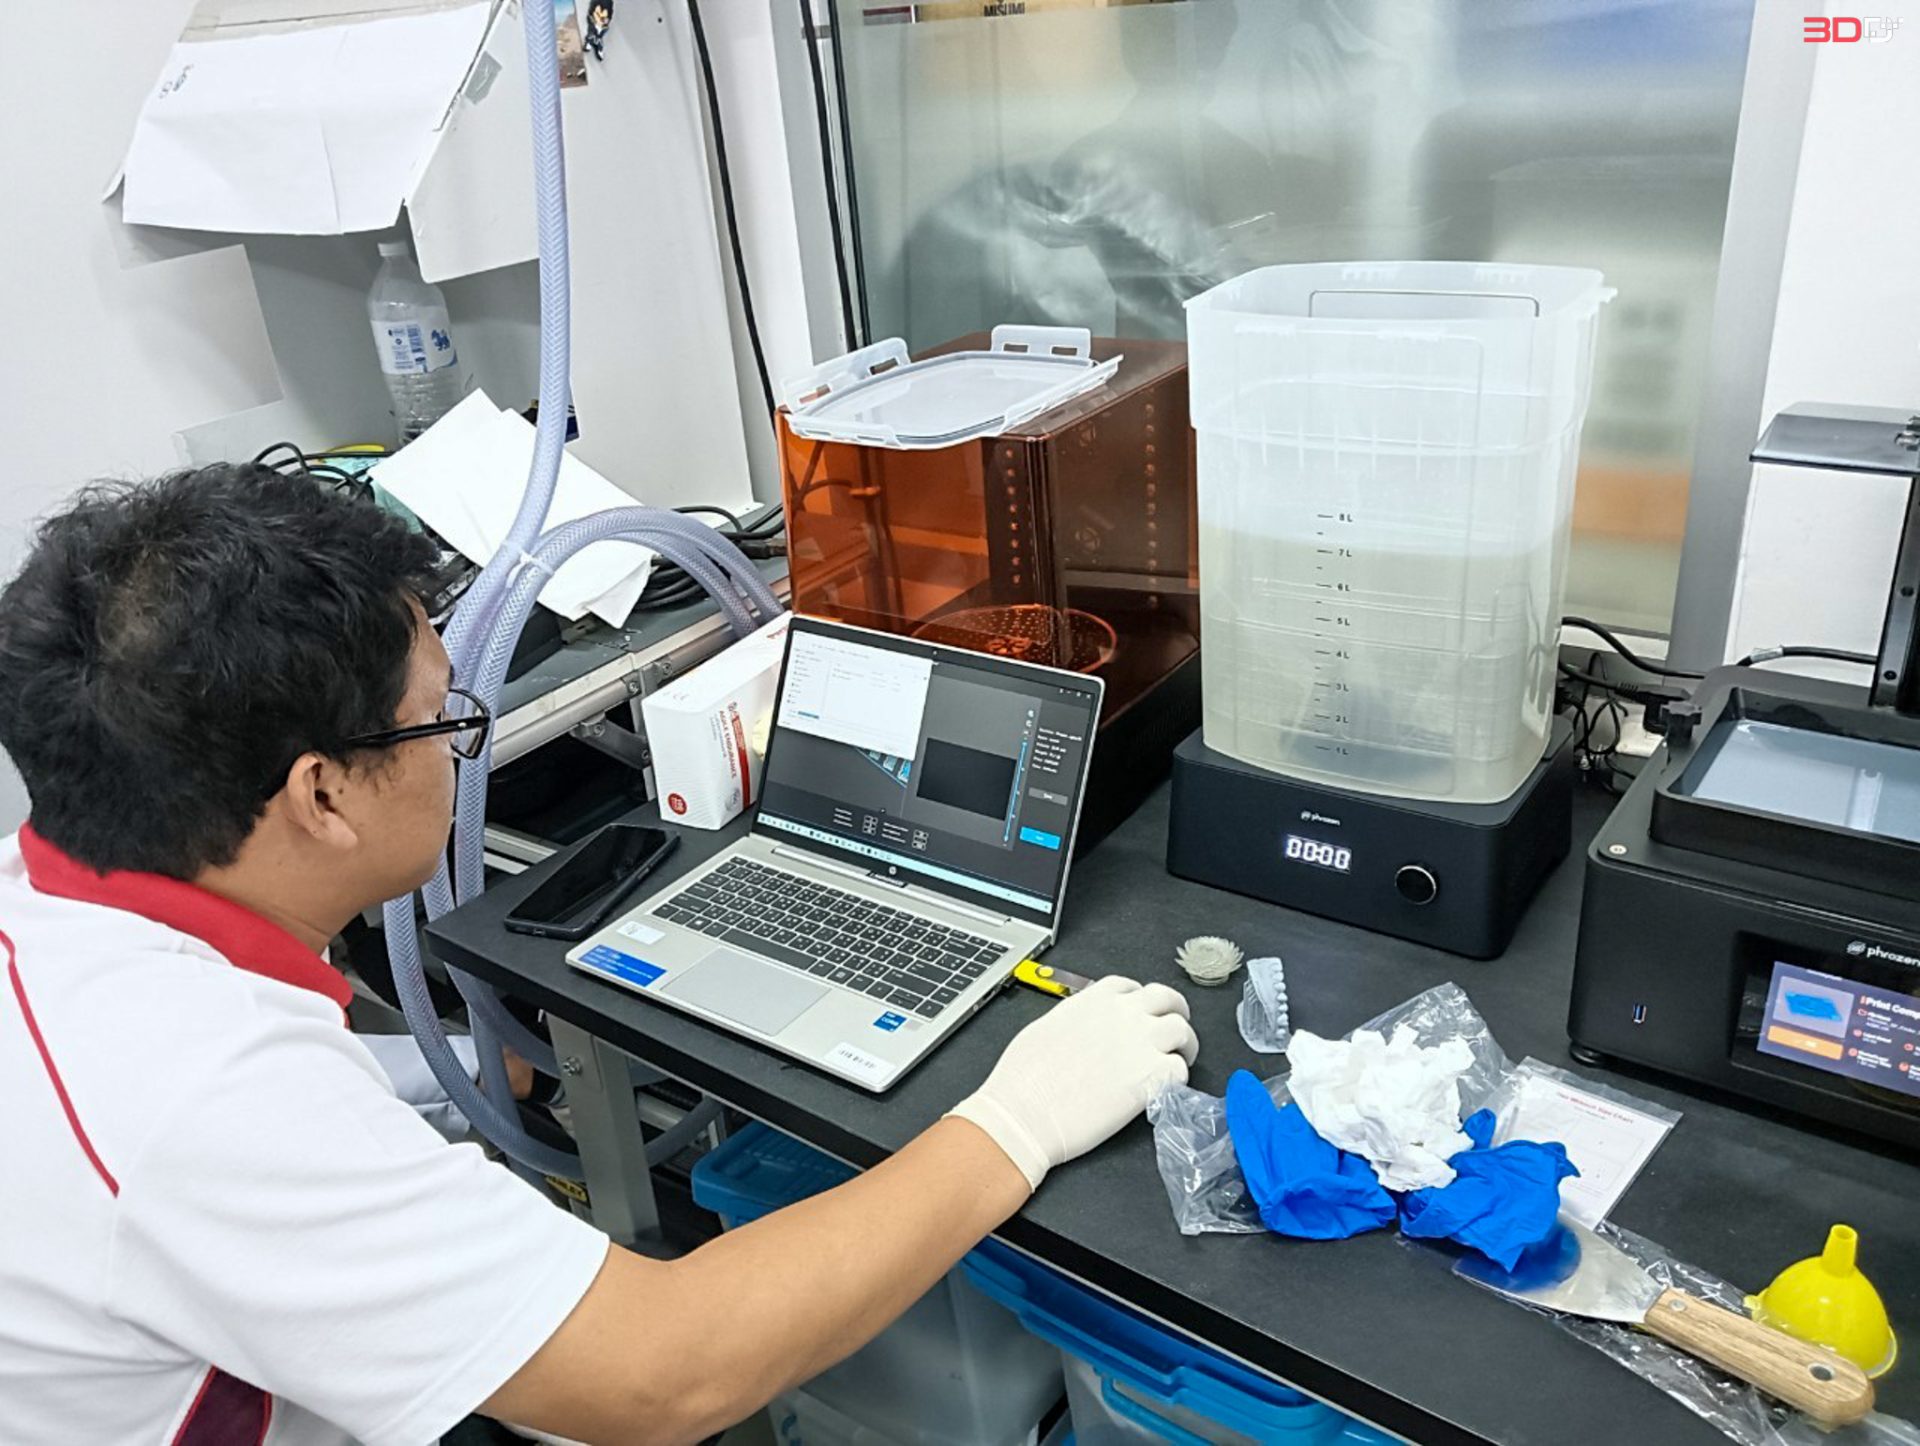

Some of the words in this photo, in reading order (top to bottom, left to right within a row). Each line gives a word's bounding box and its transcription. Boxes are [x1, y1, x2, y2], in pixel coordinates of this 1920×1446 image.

[983, 3, 1026, 17] MISUMI
[1286, 837, 1351, 870] 00:00
[1866, 945, 1920, 967] phrozen
[1866, 996, 1892, 1011] Print
